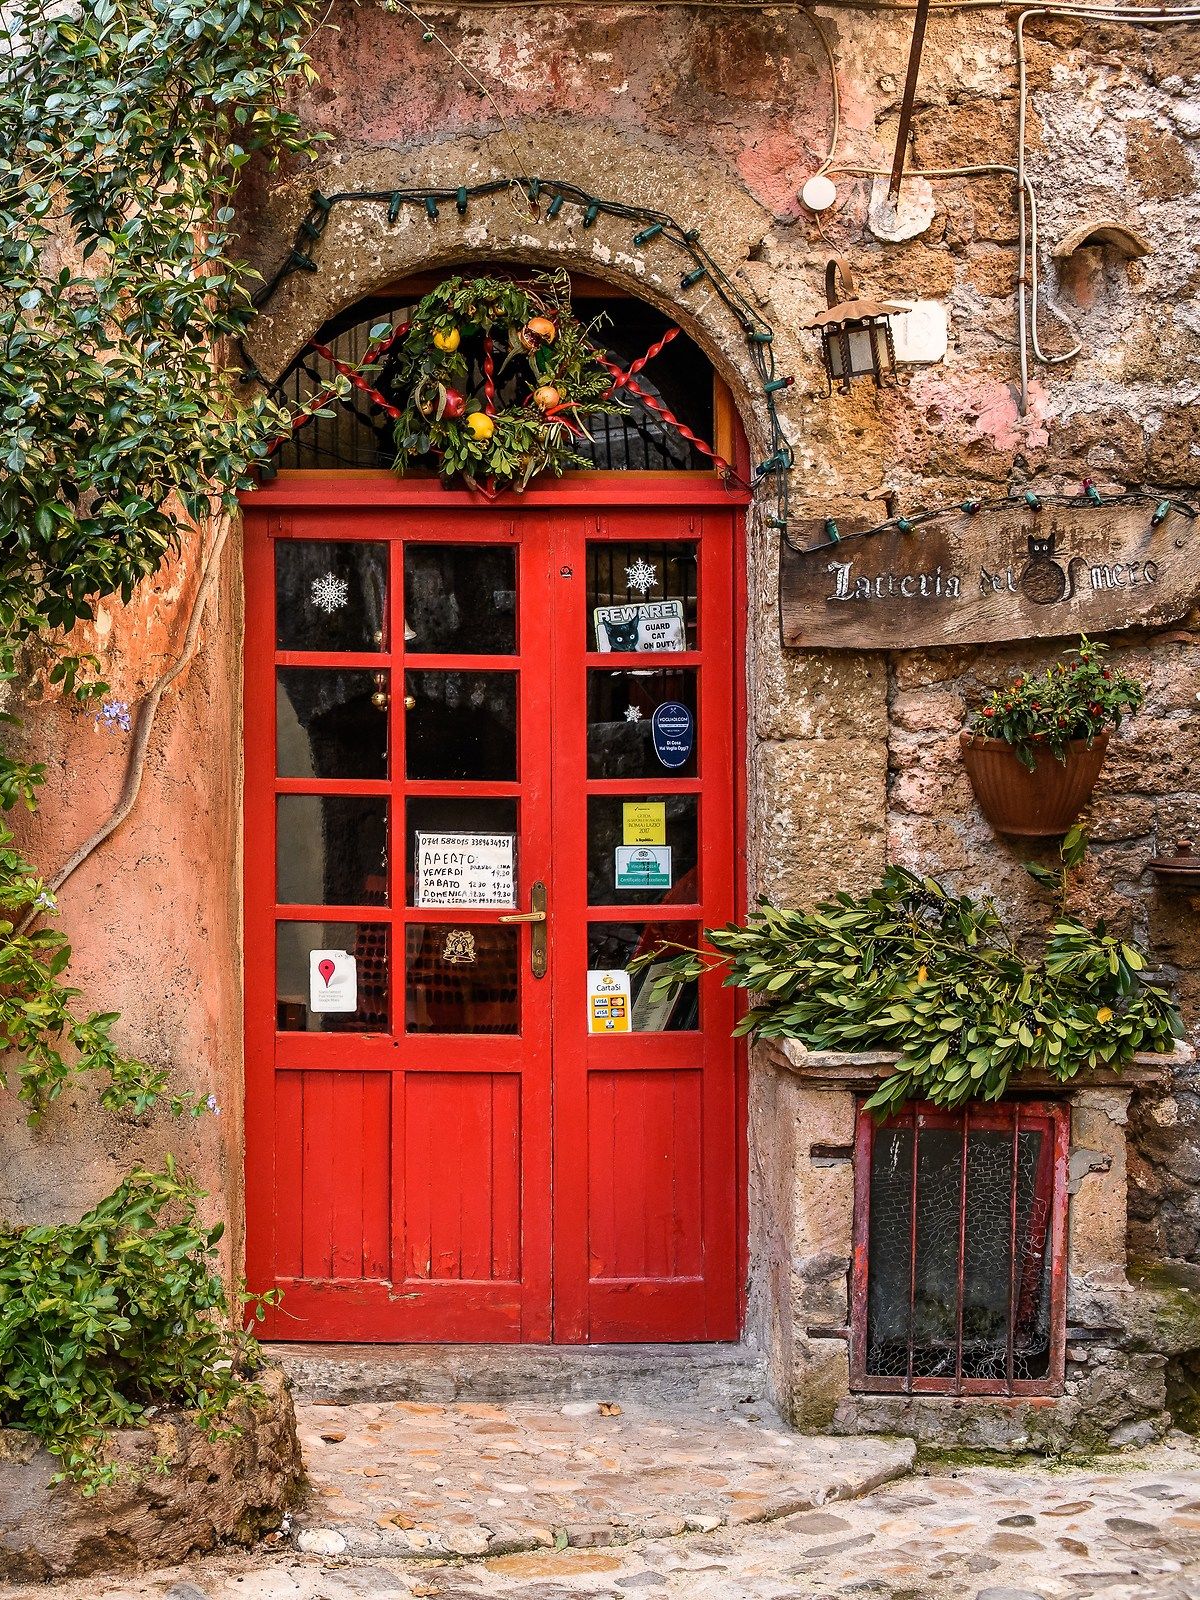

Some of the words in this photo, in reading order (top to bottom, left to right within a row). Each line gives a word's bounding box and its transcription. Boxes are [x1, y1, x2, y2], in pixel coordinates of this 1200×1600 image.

[597, 603, 678, 623] BEWARE!
[645, 623, 670, 631] GUARD
[652, 632, 666, 640] CAT
[643, 642, 654, 650] ON
[656, 641, 675, 649] DUTY
[421, 837, 439, 846] 0761
[440, 837, 469, 846] 588015
[424, 879, 460, 888] SABATO
[423, 889, 467, 898] DOMENICA
[493, 890, 511, 898] 19.30
[596, 984, 621, 992] CartaSi
